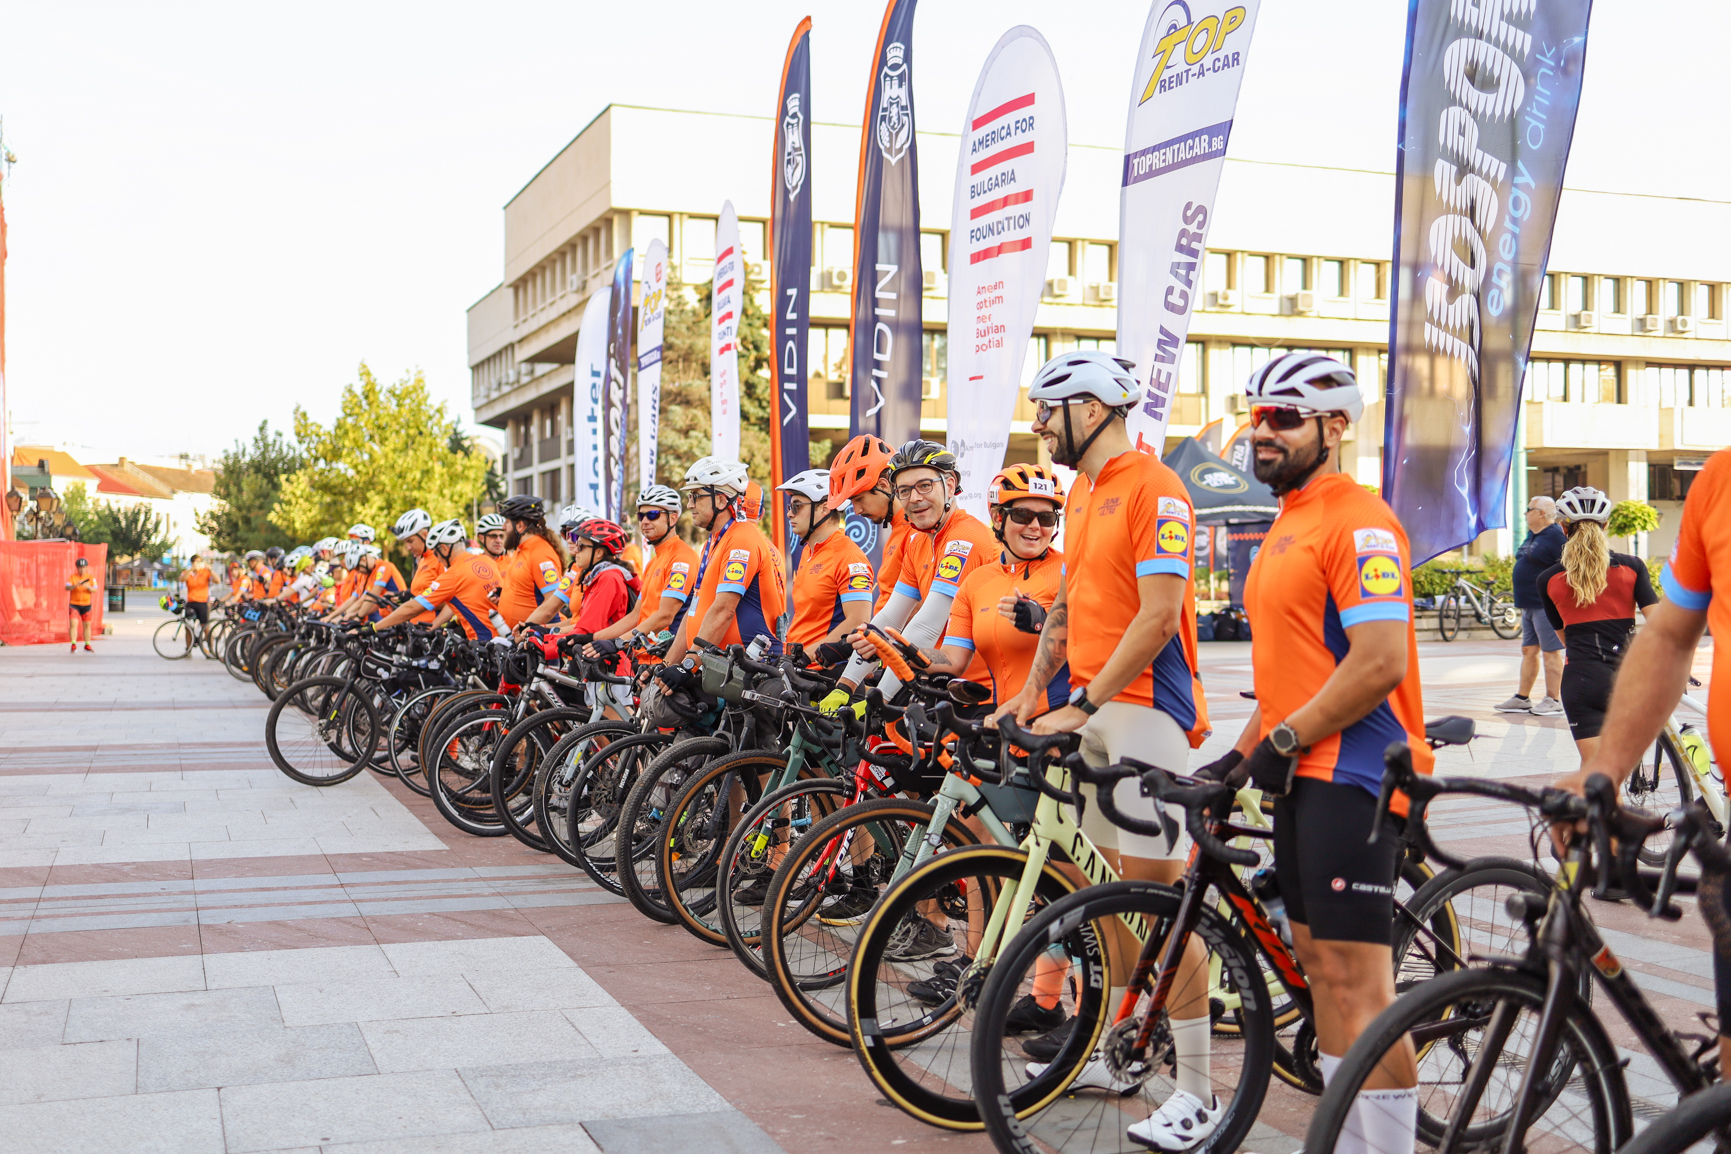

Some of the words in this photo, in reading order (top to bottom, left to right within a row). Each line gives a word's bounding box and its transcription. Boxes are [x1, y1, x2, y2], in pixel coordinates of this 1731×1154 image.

[1137, 6, 1246, 108] TOP
[1158, 51, 1240, 94] RENT-A-CAR
[971, 122, 1012, 156] AMERICA
[1014, 115, 1035, 136] FOR
[1132, 134, 1224, 177] TOPRENTACAR.BG
[970, 168, 1017, 200] BULGARIA
[1487, 160, 1536, 317] energy
[1526, 41, 1556, 150] drink
[1142, 324, 1181, 423] NEW
[1163, 200, 1208, 316] CARS
[783, 287, 798, 426] VIDIN
[865, 263, 899, 418] VIDIN
[1034, 482, 1048, 491] 121
[1089, 961, 1102, 989] DT
